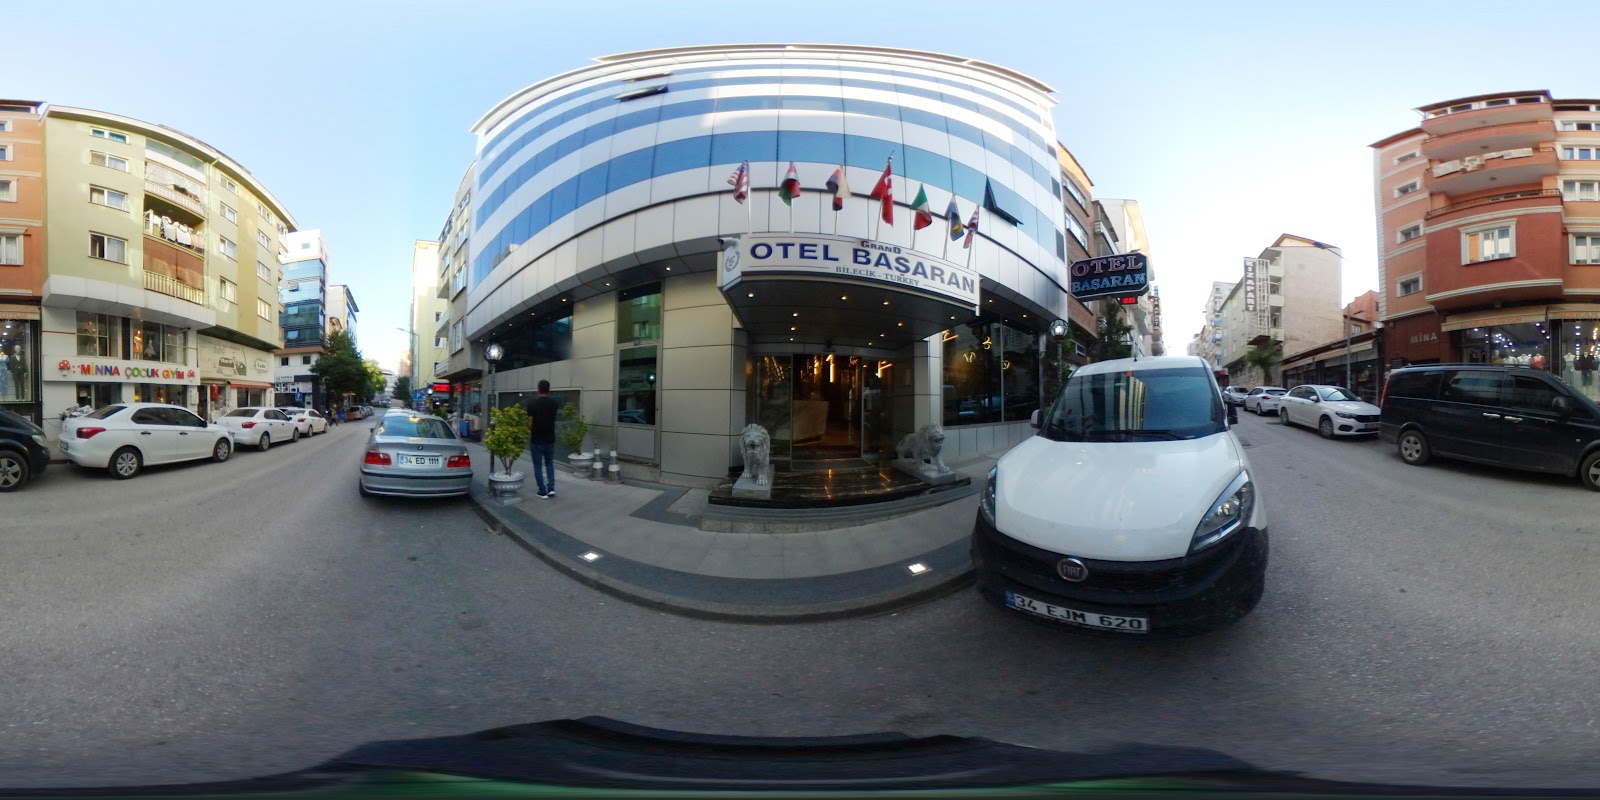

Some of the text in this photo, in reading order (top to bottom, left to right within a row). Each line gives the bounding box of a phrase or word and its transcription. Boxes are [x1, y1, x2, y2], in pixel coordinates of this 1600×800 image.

[860, 240, 902, 254] GRAND
[750, 242, 975, 295] OTEL BAŞARAN
[836, 266, 876, 278] BİLECİK
[1071, 255, 1144, 277] OTEL
[1071, 272, 1147, 294] BAŞARAN
[80, 362, 185, 379] MİNNA ÇOCUK GİYİM
[404, 456, 439, 465] 34 ED 1111
[1062, 564, 1081, 577] FIAT
[1016, 595, 1142, 630] 34 EJM 620
